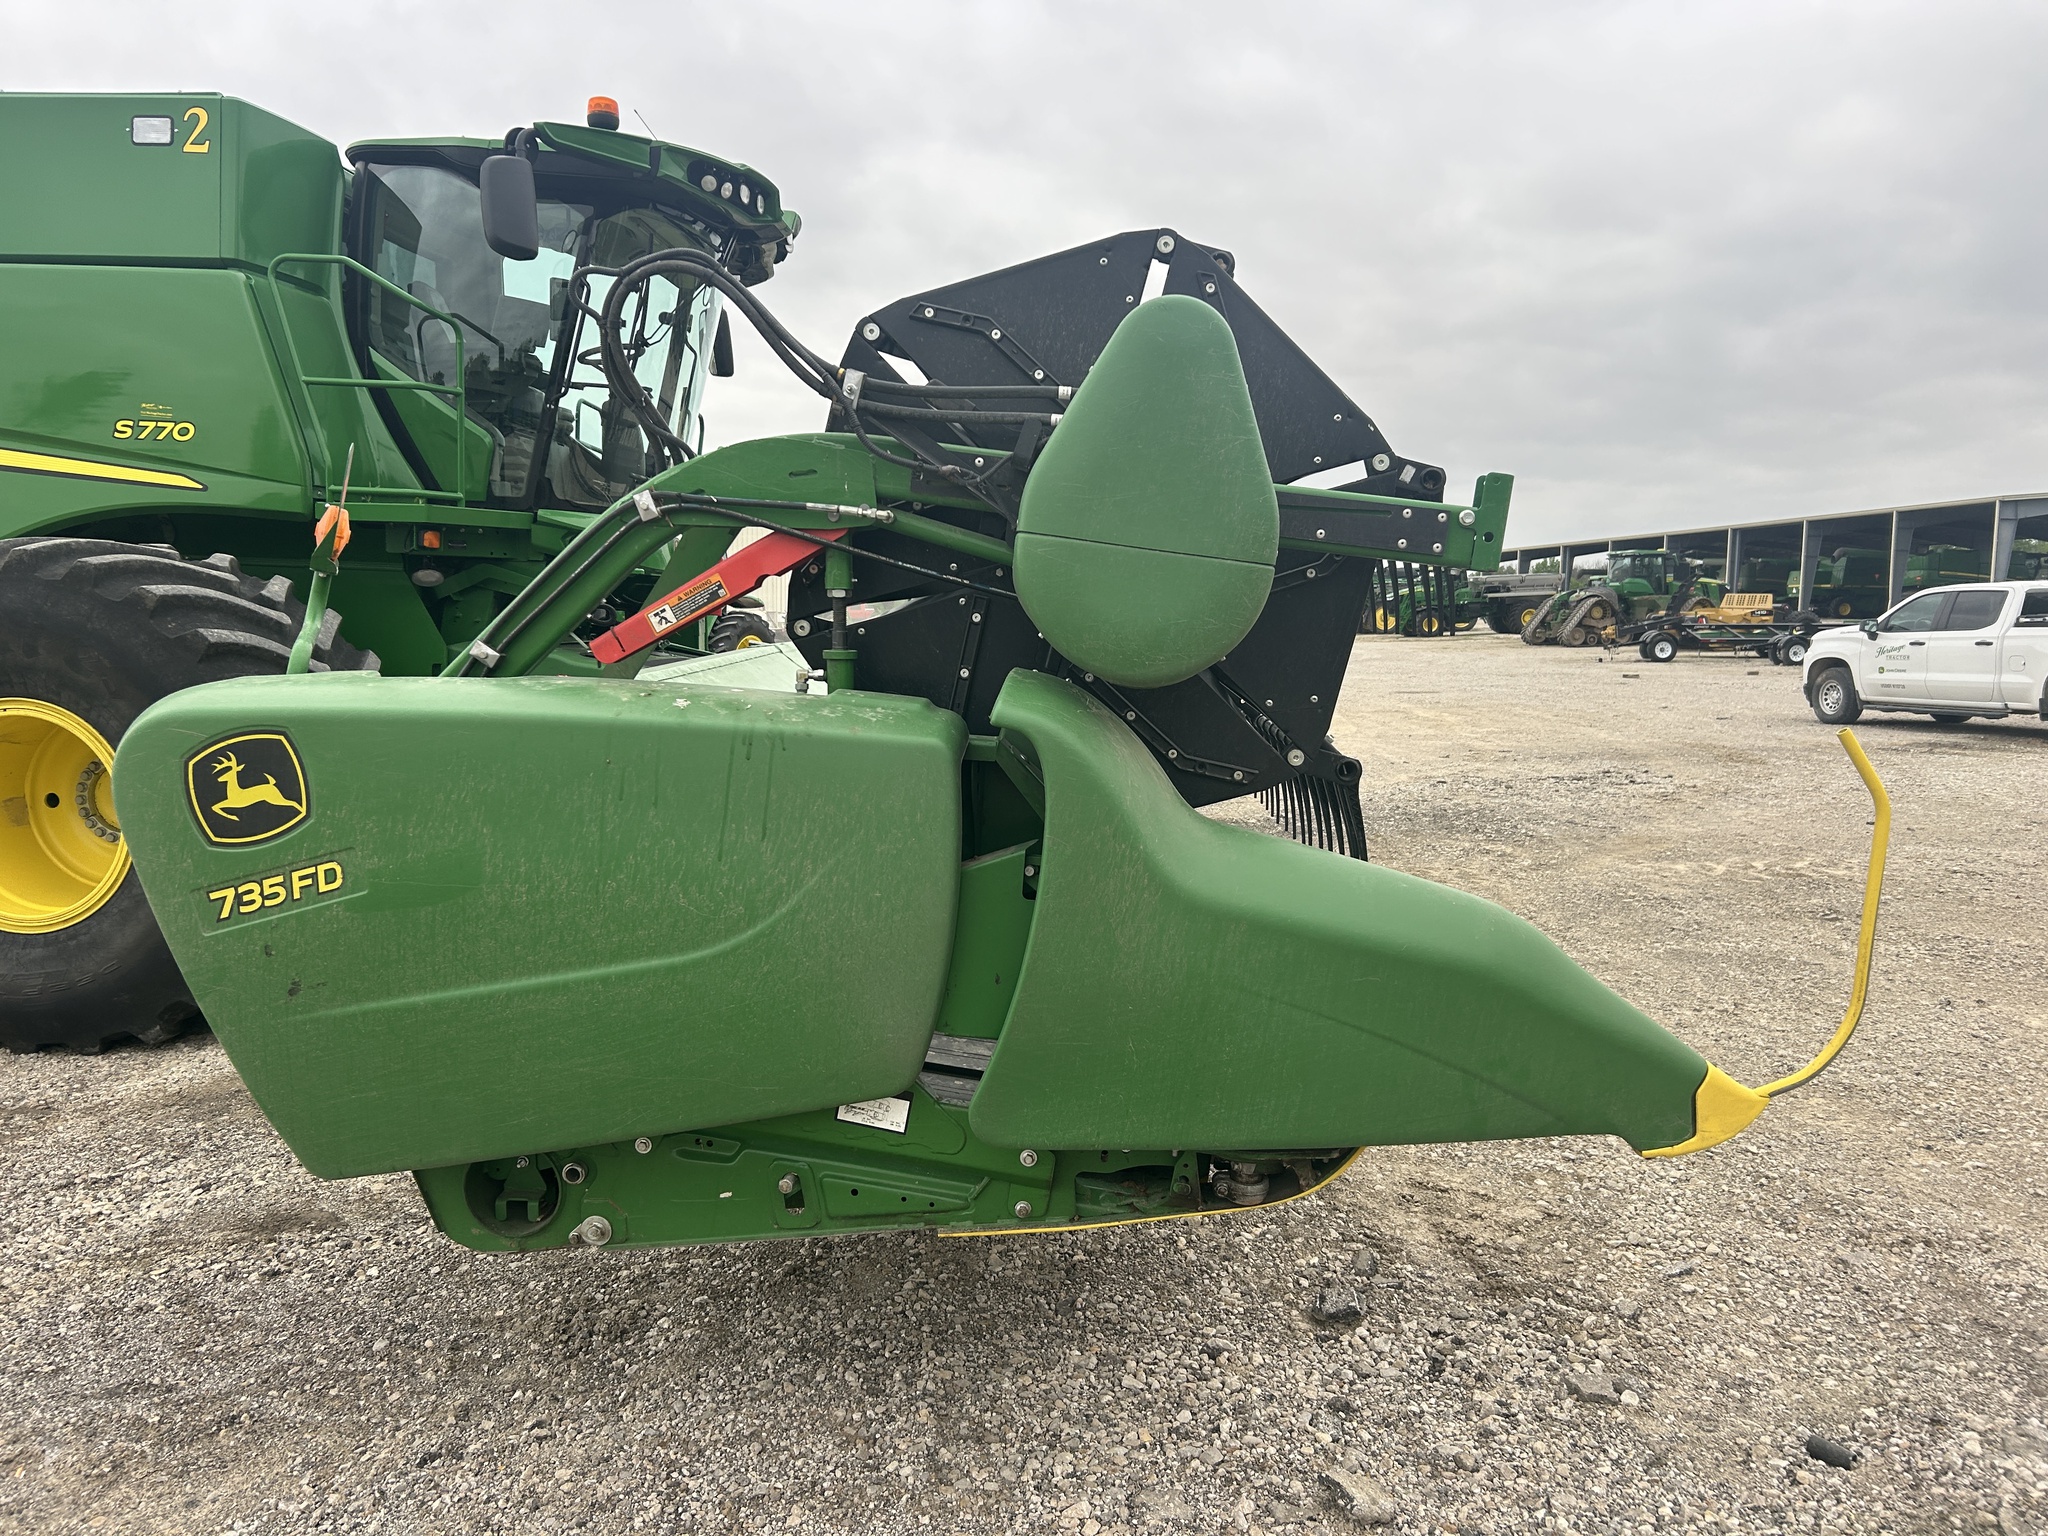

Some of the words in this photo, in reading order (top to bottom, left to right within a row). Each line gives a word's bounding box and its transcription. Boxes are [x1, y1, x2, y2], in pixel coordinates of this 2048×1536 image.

[181, 105, 212, 154] 2
[113, 418, 197, 442] S770
[683, 579, 713, 598] WARNING
[1875, 644, 1906, 659] Heritage
